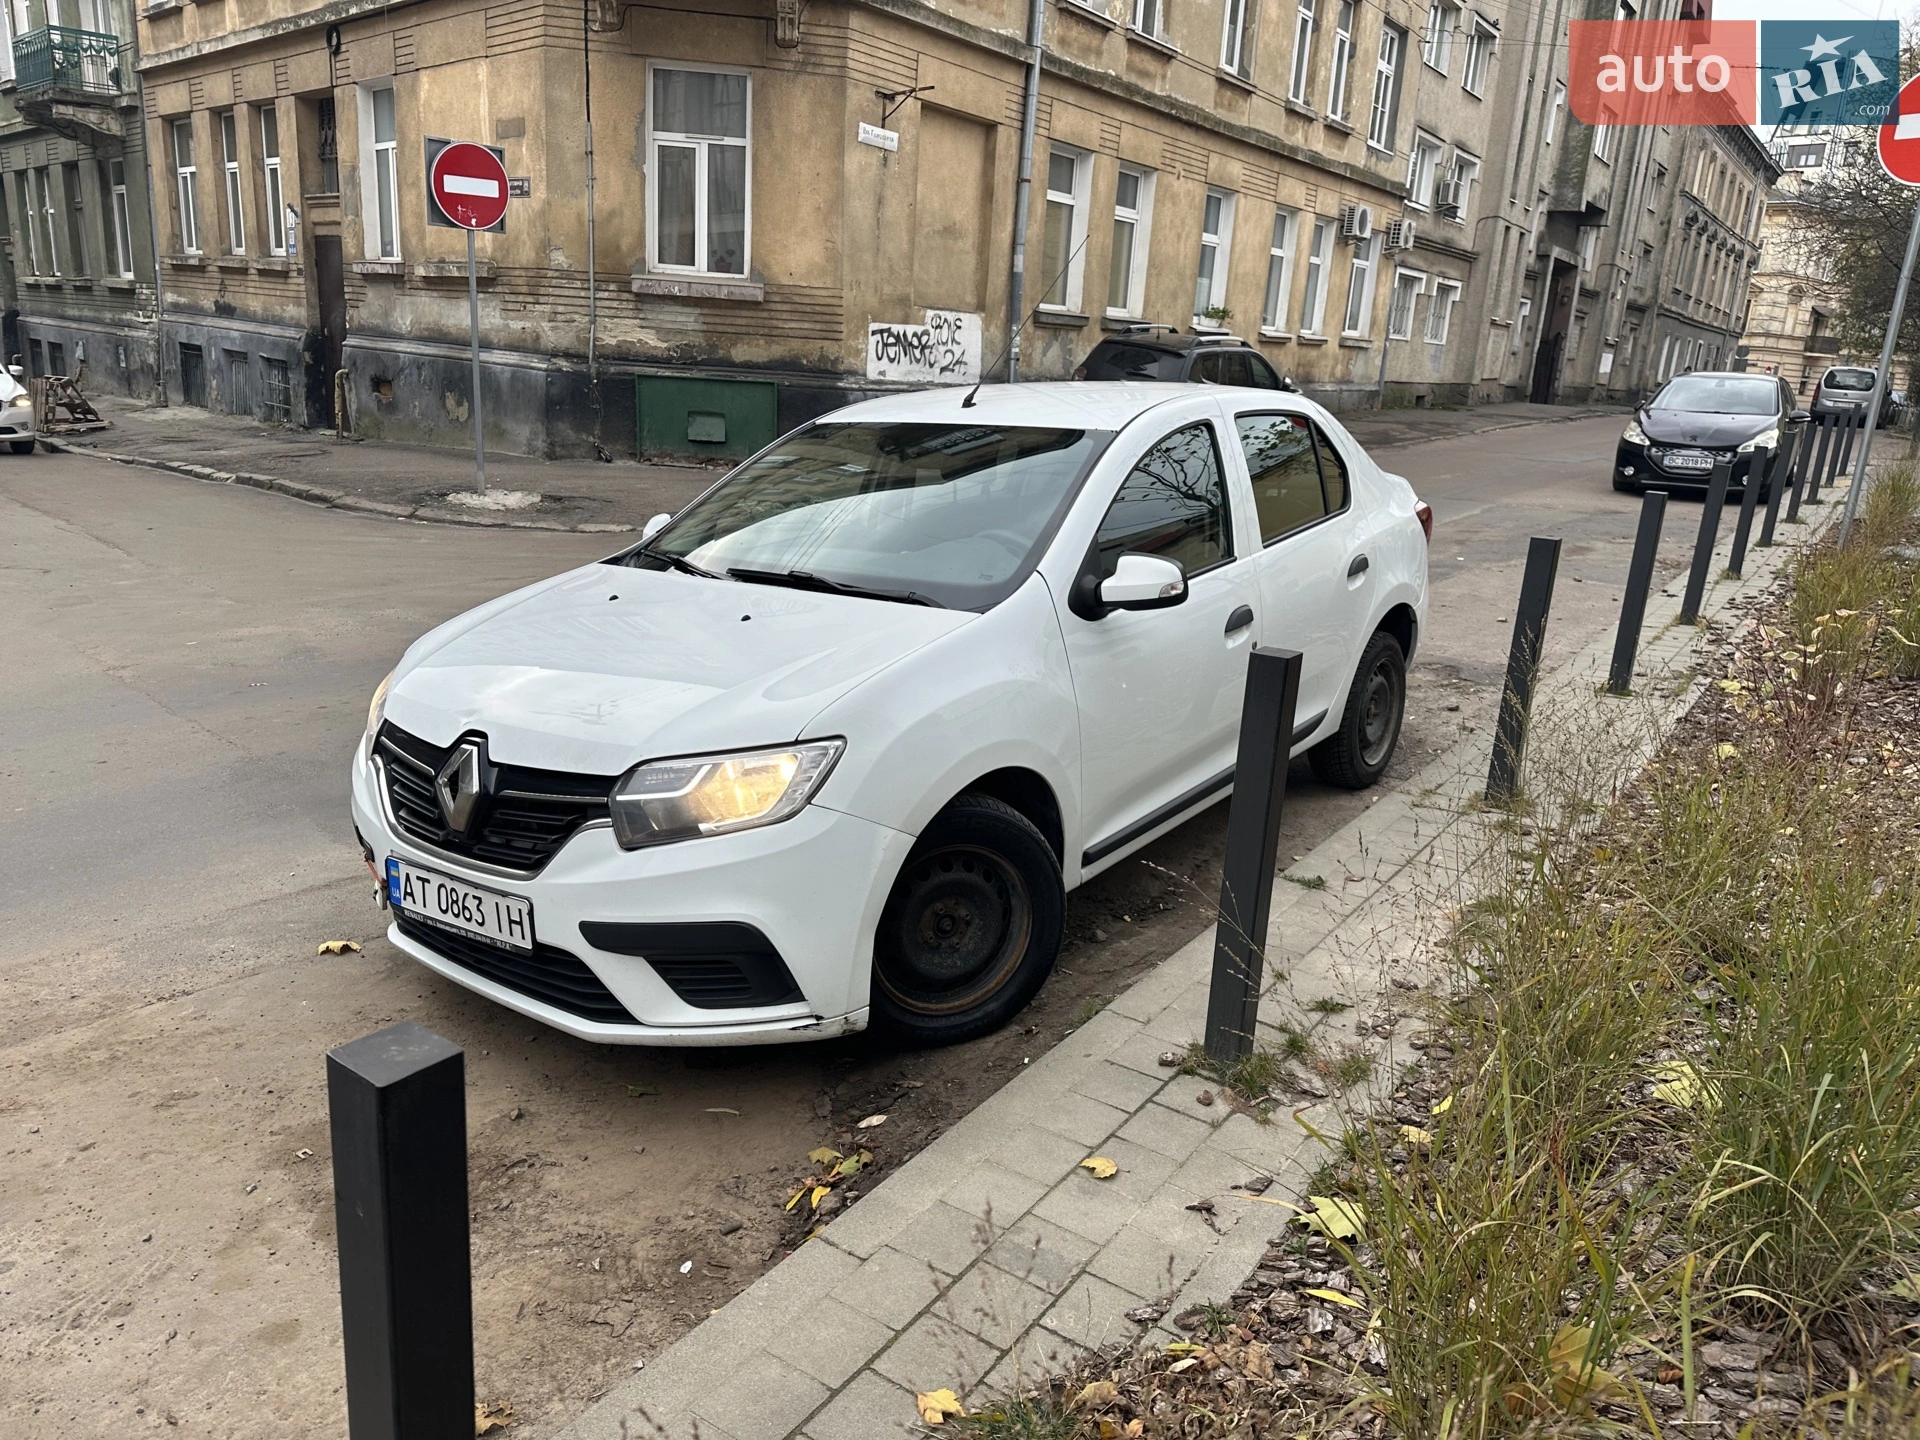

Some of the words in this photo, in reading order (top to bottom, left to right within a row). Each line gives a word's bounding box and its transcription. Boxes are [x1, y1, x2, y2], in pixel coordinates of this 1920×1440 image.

[1668, 456, 1680, 465] BC
[1680, 457, 1699, 466] 2018
[391, 888, 400, 899] UA
[403, 872, 431, 909] AT
[437, 883, 486, 926] 0863
[495, 901, 526, 941] IH
